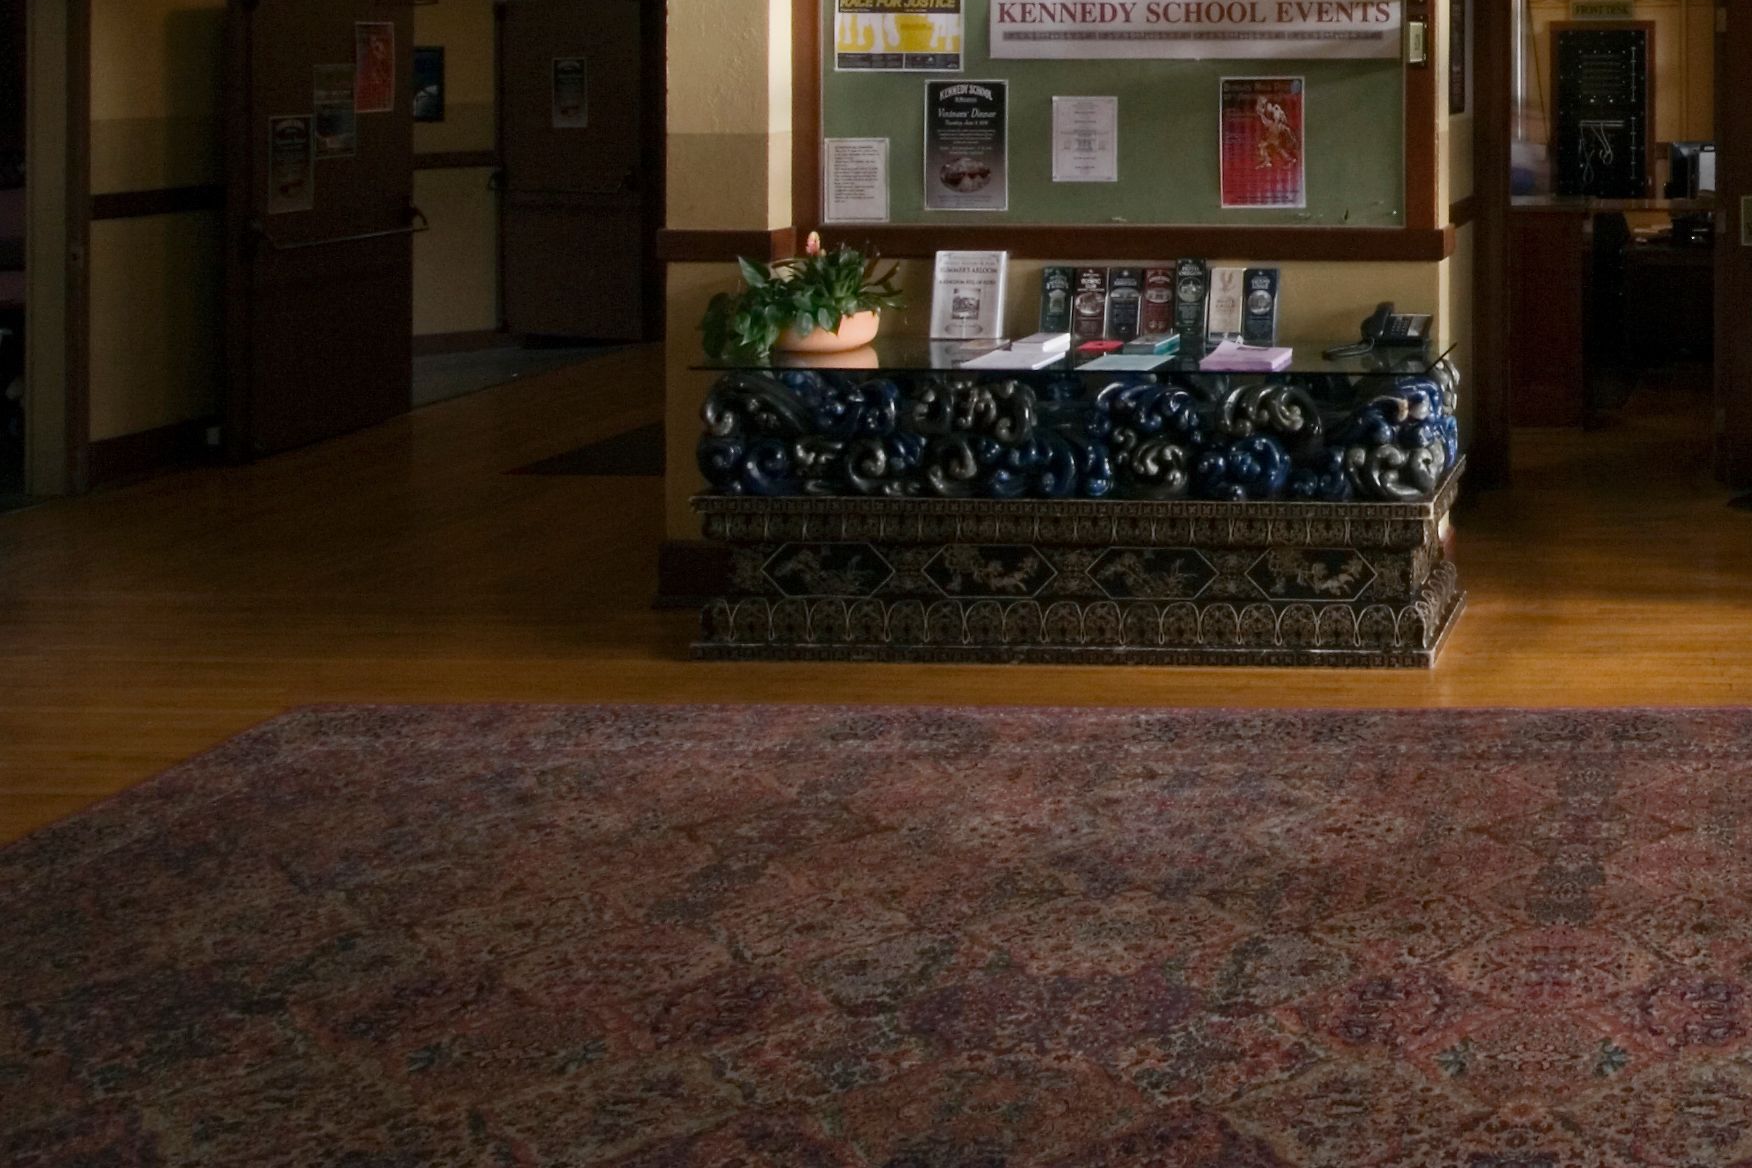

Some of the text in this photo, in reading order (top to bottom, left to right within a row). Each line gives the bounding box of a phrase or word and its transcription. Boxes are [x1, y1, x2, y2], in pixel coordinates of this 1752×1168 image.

[997, 0, 1392, 24] KENNEDY SCHOOL EVENTS
[939, 83, 993, 102] KENNEDY SCHOOL
